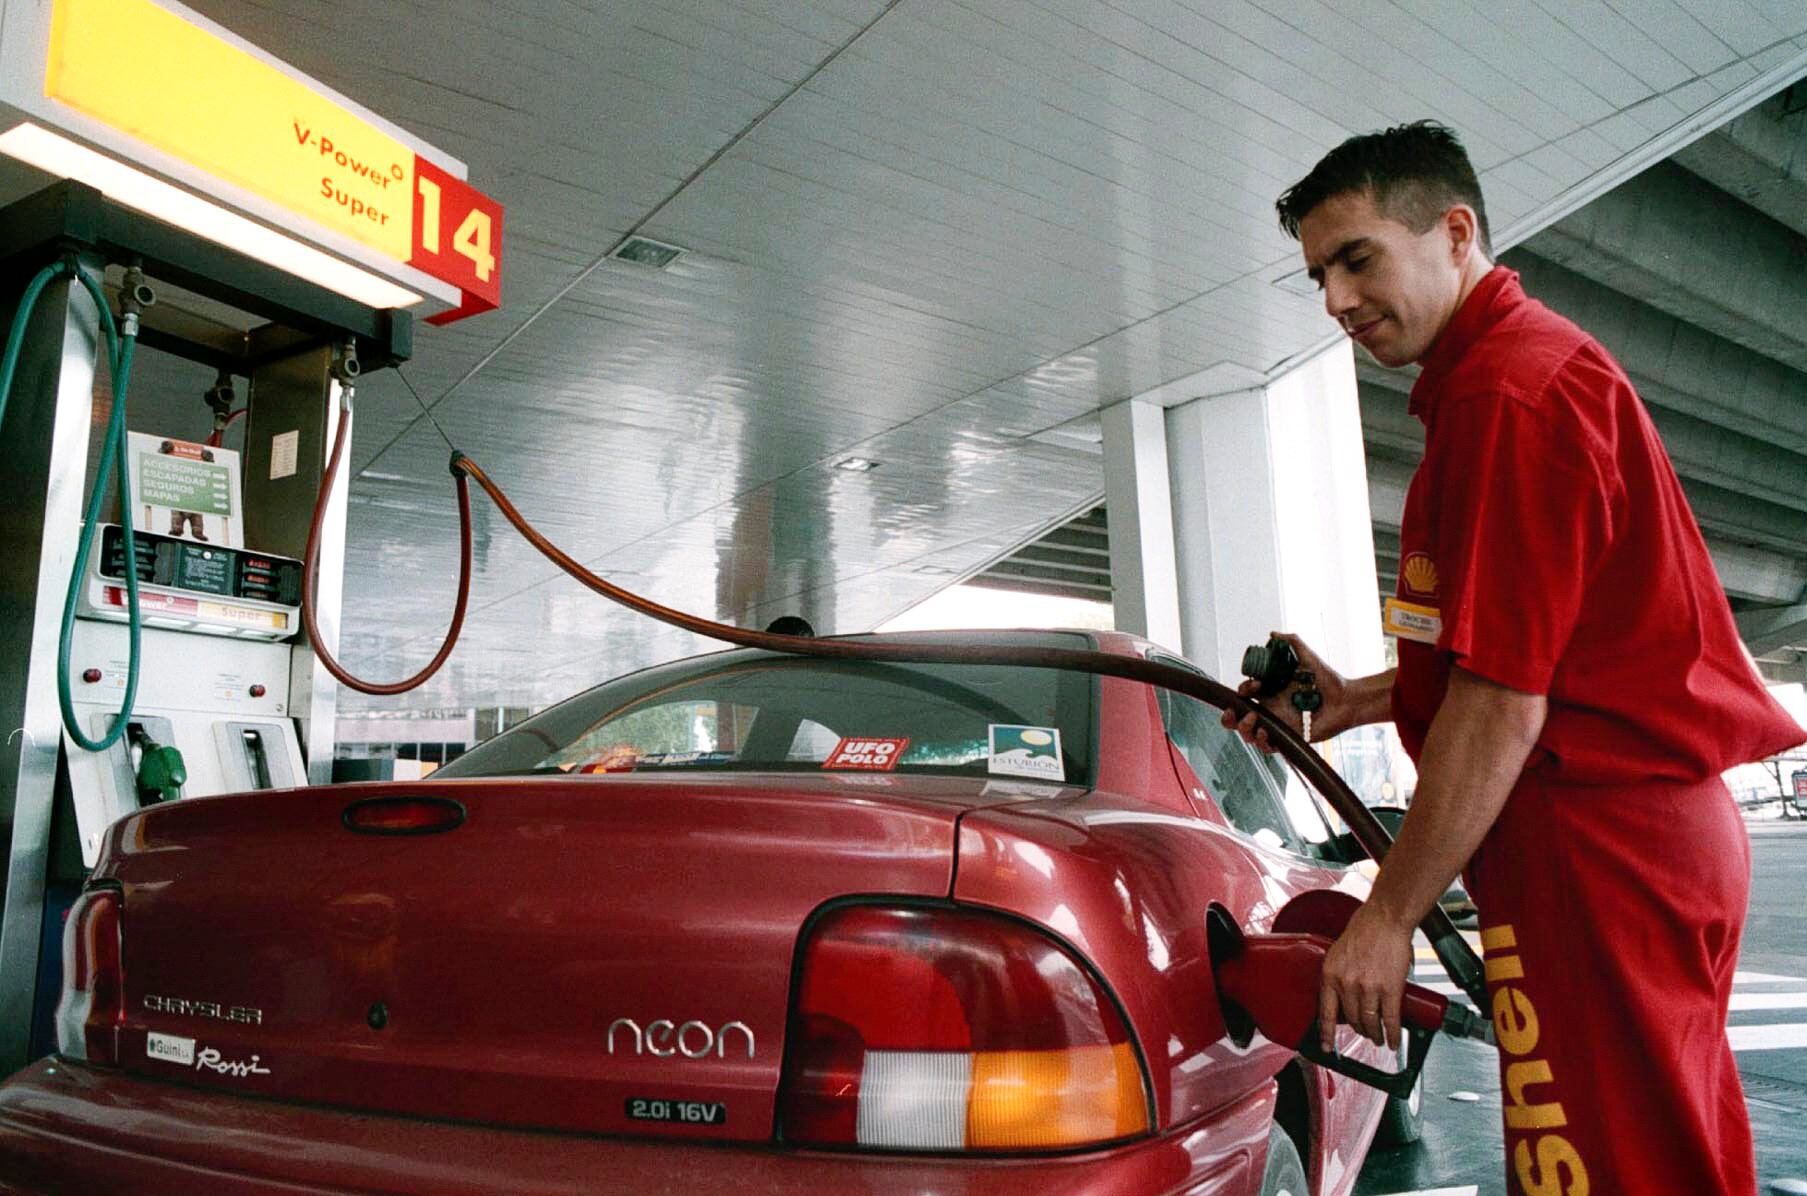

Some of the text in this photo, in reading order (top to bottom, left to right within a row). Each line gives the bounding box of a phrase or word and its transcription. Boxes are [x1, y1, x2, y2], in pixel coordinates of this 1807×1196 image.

[294, 122, 391, 190] V-Power
[320, 177, 390, 226] Super
[418, 175, 496, 283] 14
[143, 468, 207, 487] ESCAPADAS
[143, 478, 195, 495] SEGUROS
[143, 489, 181, 502] MAPAS
[835, 753, 889, 765] POLO
[844, 742, 896, 754] UFO
[144, 994, 262, 1025] CHRYSLER
[608, 1018, 755, 1059] neon
[196, 1046, 271, 1077] Rossi
[1481, 923, 1590, 1196] Shell
[632, 1099, 718, 1122] 2.0i 16V
